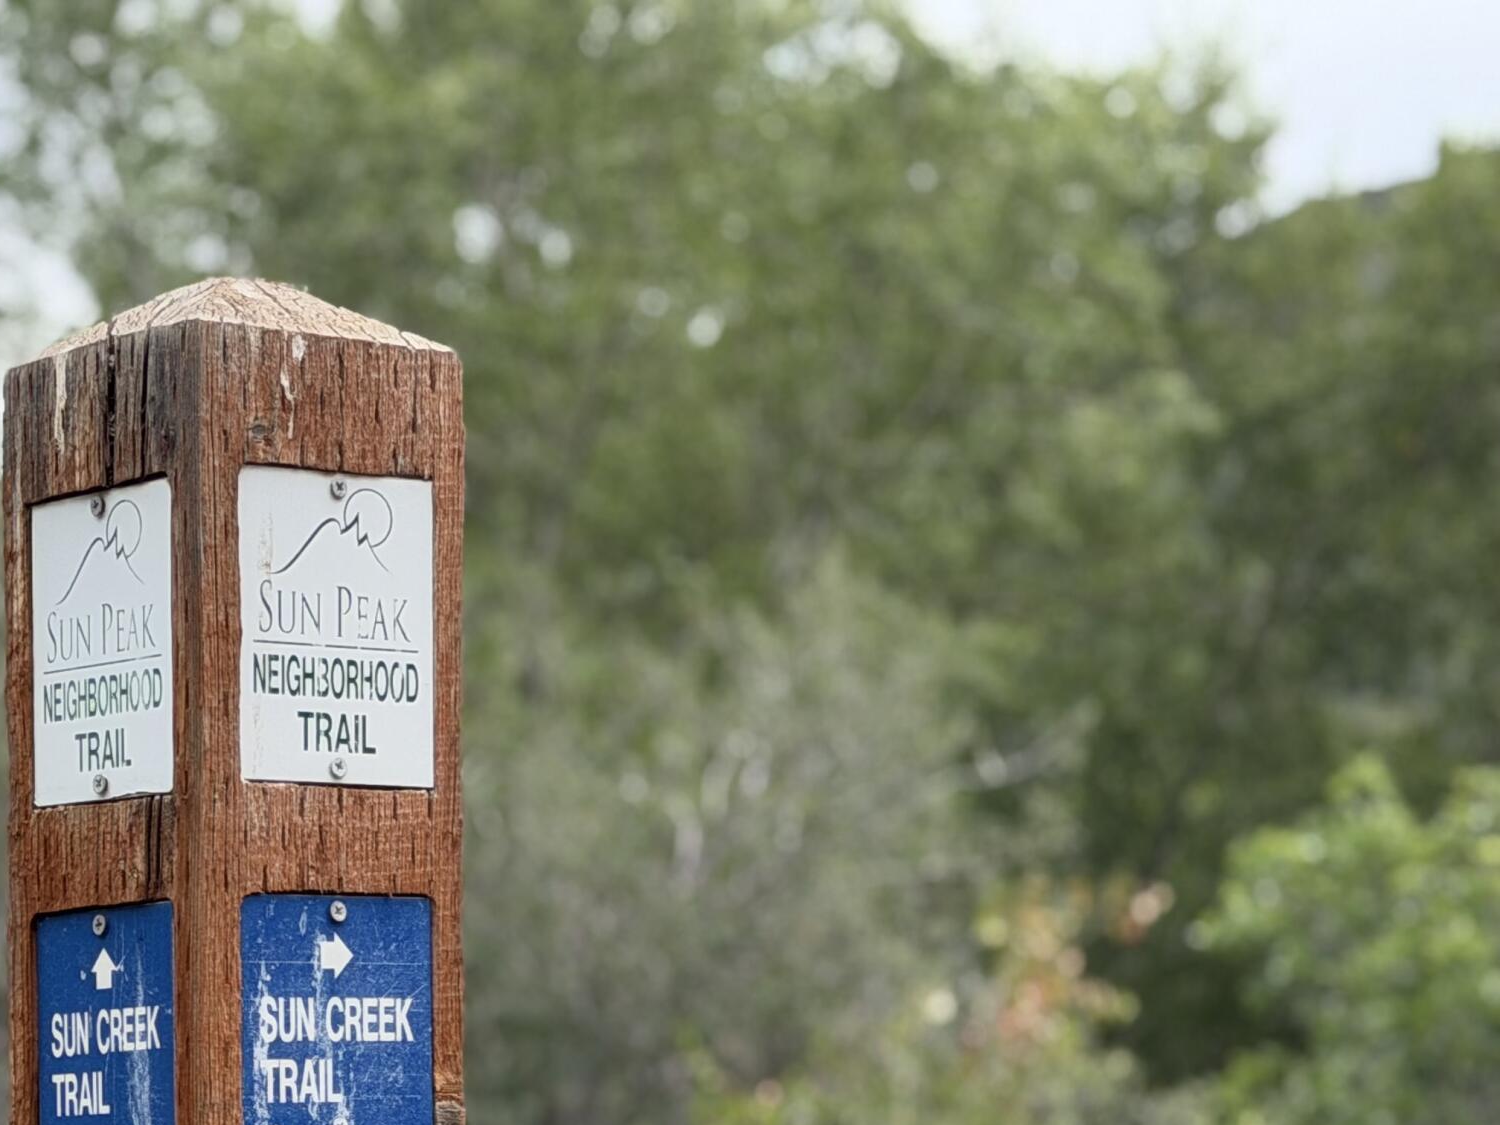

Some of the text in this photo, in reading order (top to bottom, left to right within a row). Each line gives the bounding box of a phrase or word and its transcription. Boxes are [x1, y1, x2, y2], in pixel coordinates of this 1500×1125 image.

[47, 602, 156, 663] SUN PEAK
[259, 580, 411, 643] SUN PEAK
[43, 668, 162, 724] NEIGHBORHOOD
[253, 653, 419, 703] NEIGHBORHOOD
[75, 728, 131, 772] TRAIL
[297, 711, 376, 755] TRAIL
[51, 1005, 160, 1058] SUN CREEK
[260, 996, 414, 1043] SUN CREEK
[52, 1072, 110, 1117] TRAIL
[260, 1058, 343, 1103] TRAIL
